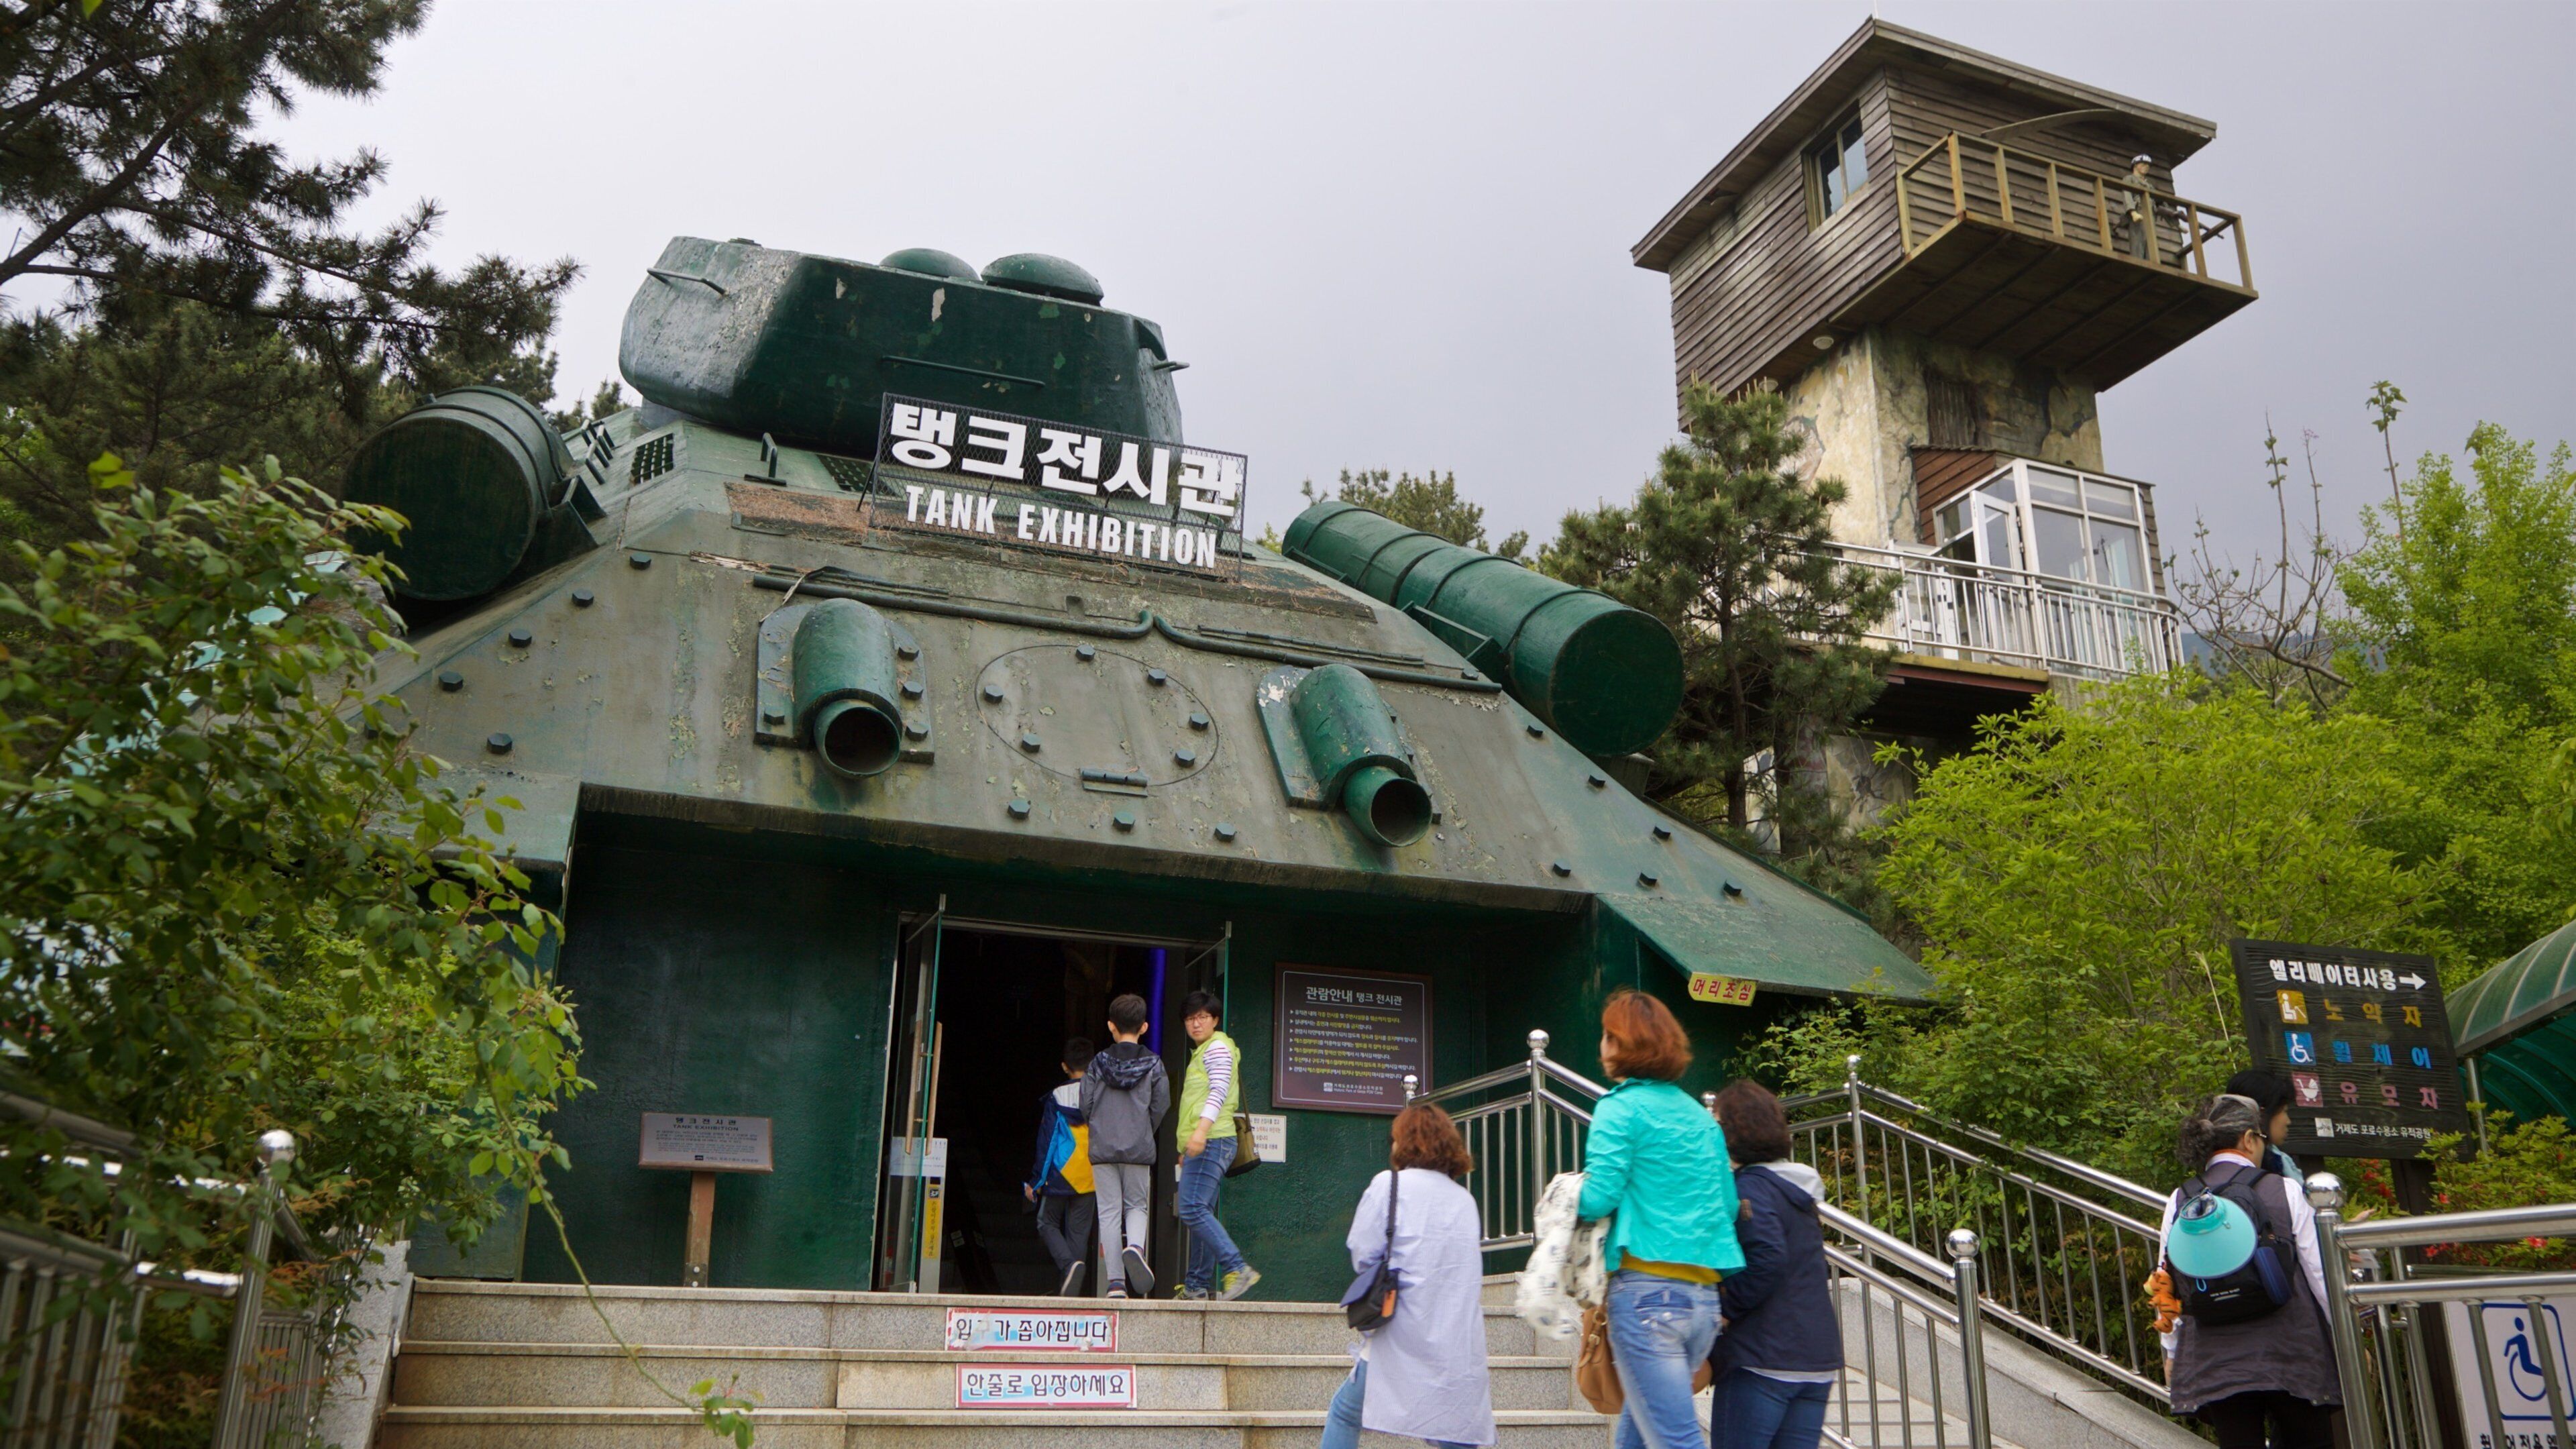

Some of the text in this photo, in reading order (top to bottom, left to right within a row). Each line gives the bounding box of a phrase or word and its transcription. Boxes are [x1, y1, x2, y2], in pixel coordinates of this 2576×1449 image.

[890, 402, 1242, 517] 탱크전시관
[906, 484, 1217, 569] TANK EXHIBITION
[1306, 986, 1352, 1003] 관람안내
[1376, 994, 1402, 1006] 전시관
[1693, 978, 1752, 1001] 머리조심
[2324, 999, 2422, 1028] 노약자
[2340, 1081, 2438, 1110] 유모차
[2335, 1123, 2359, 1134] 거제도
[2361, 1124, 2399, 1137] 포로수용소
[1018, 1320, 1108, 1342] 좁아집니다
[967, 1373, 1124, 1397] 한줄로 입장하세요
